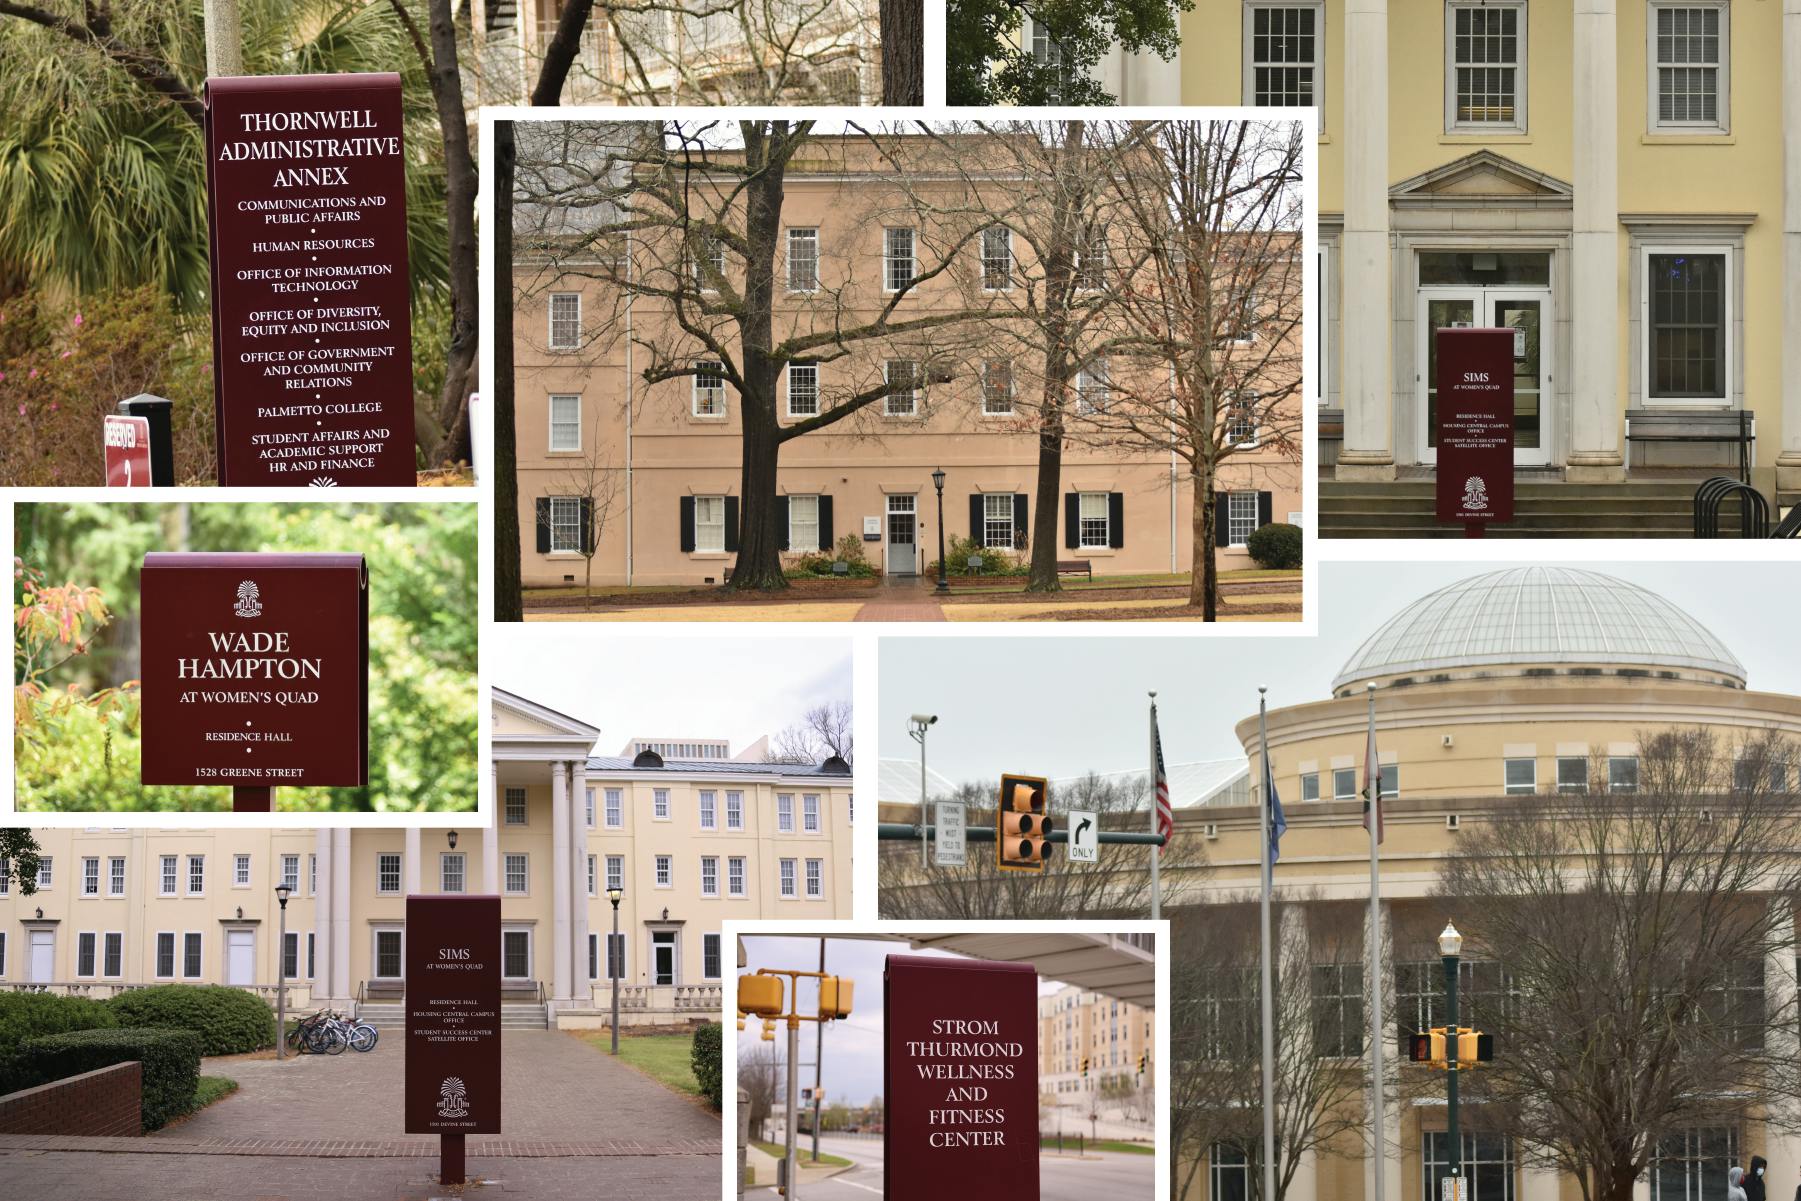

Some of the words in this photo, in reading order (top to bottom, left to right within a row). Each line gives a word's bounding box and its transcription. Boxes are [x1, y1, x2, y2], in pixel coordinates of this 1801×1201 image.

[240, 110, 377, 132] THORNWELL
[219, 137, 399, 161] ADMINISTRATIVE
[273, 167, 349, 187] ANNEX
[238, 198, 356, 211] COMMUNICATIONS
[359, 196, 386, 206] AND
[265, 213, 309, 224] PUBLIC
[313, 211, 360, 222] AFFAIRS
[253, 241, 299, 252] HUMAN
[304, 238, 375, 250] RESOURCES
[237, 269, 281, 280] OFFICE
[285, 268, 301, 278] OF
[305, 264, 392, 277] INFORMATION
[272, 280, 359, 293] TECHNOLOGY
[249, 310, 293, 321] OFFICE
[297, 309, 314, 319] OF
[317, 307, 381, 319] DIVERSITY,
[242, 325, 288, 338] EQUITY
[291, 324, 317, 334] AND
[321, 320, 390, 333] INCLUSION
[240, 351, 285, 363] OFFICE
[289, 351, 305, 360] OF
[308, 347, 395, 359] GOVERNMENT
[264, 365, 290, 376] AND
[294, 362, 373, 374] COMMUNITY
[285, 377, 352, 389] RELATIONS
[1464, 373, 1489, 382] SIMS
[258, 405, 322, 417] PALMETTO
[325, 402, 382, 413] COLLEGE
[105, 422, 135, 448] RESERVED
[252, 433, 309, 445] STUDENT
[312, 431, 360, 442] AFFAIRS
[363, 429, 390, 439] AND
[259, 447, 325, 459] ACADEMIC
[329, 443, 383, 455] SUPPORT
[269, 462, 287, 472] HR
[291, 460, 317, 471] AND
[320, 458, 375, 470] FINANCE
[208, 632, 289, 652] WADE
[178, 658, 321, 679] HAMPTON
[180, 692, 198, 703] AT
[202, 692, 271, 703] WOMEN'S
[276, 692, 318, 706] QUAD
[206, 733, 261, 741] RESIDENCE
[265, 733, 292, 741] HALL
[196, 768, 217, 776] 1528
[221, 768, 262, 776] GREENE
[266, 769, 304, 777] STREET
[1073, 847, 1093, 858] ONLY
[439, 949, 470, 960] SIMS
[932, 1020, 999, 1035] STROM
[907, 1042, 1023, 1057] THURMOND
[917, 1065, 1014, 1080] WELLNESS
[945, 1087, 988, 1102] AND
[929, 1109, 1004, 1124] FITNESS
[929, 1131, 1005, 1147] CENTER
